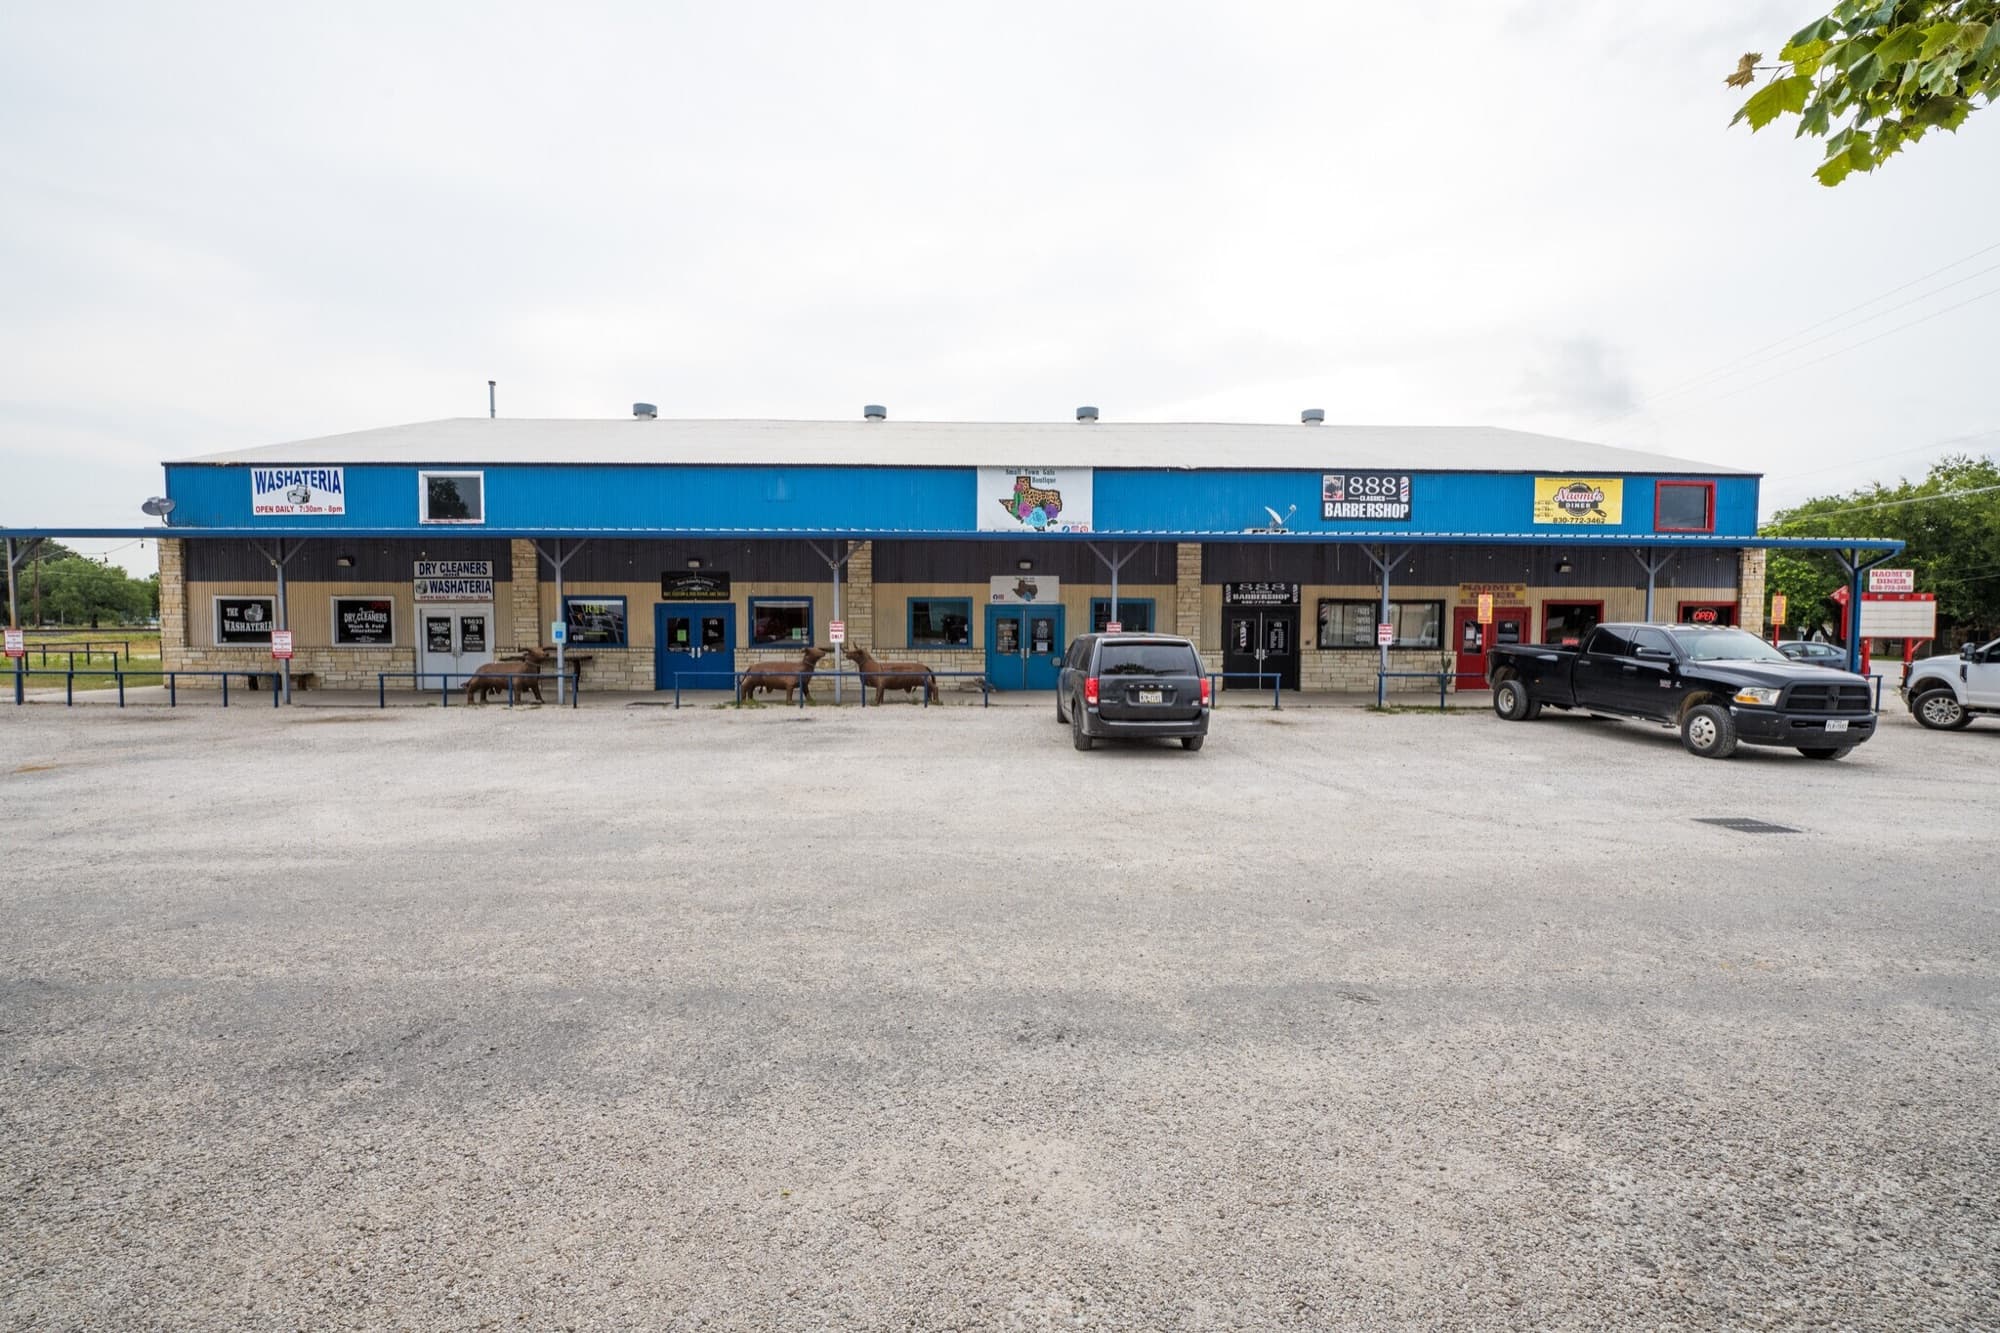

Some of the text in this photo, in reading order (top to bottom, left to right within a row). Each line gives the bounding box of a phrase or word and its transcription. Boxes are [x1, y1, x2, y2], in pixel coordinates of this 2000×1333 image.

[255, 470, 341, 495] WASHATERIA
[1032, 477, 1056, 485] Boutique
[1349, 476, 1397, 496] 888
[1553, 487, 1604, 502] Naomi's
[256, 505, 274, 513] OPEN
[276, 505, 295, 513] DAILY
[300, 505, 322, 513] 7:30am
[1324, 502, 1409, 518] BARBERSHOP
[418, 561, 488, 575] DRY CLEANERS
[429, 580, 491, 593] WASHATERIA
[226, 607, 239, 617] THE
[344, 611, 388, 624] DRY CLEANERS
[1694, 610, 1717, 621] OPEN
[224, 619, 273, 632] WASHATERIA
